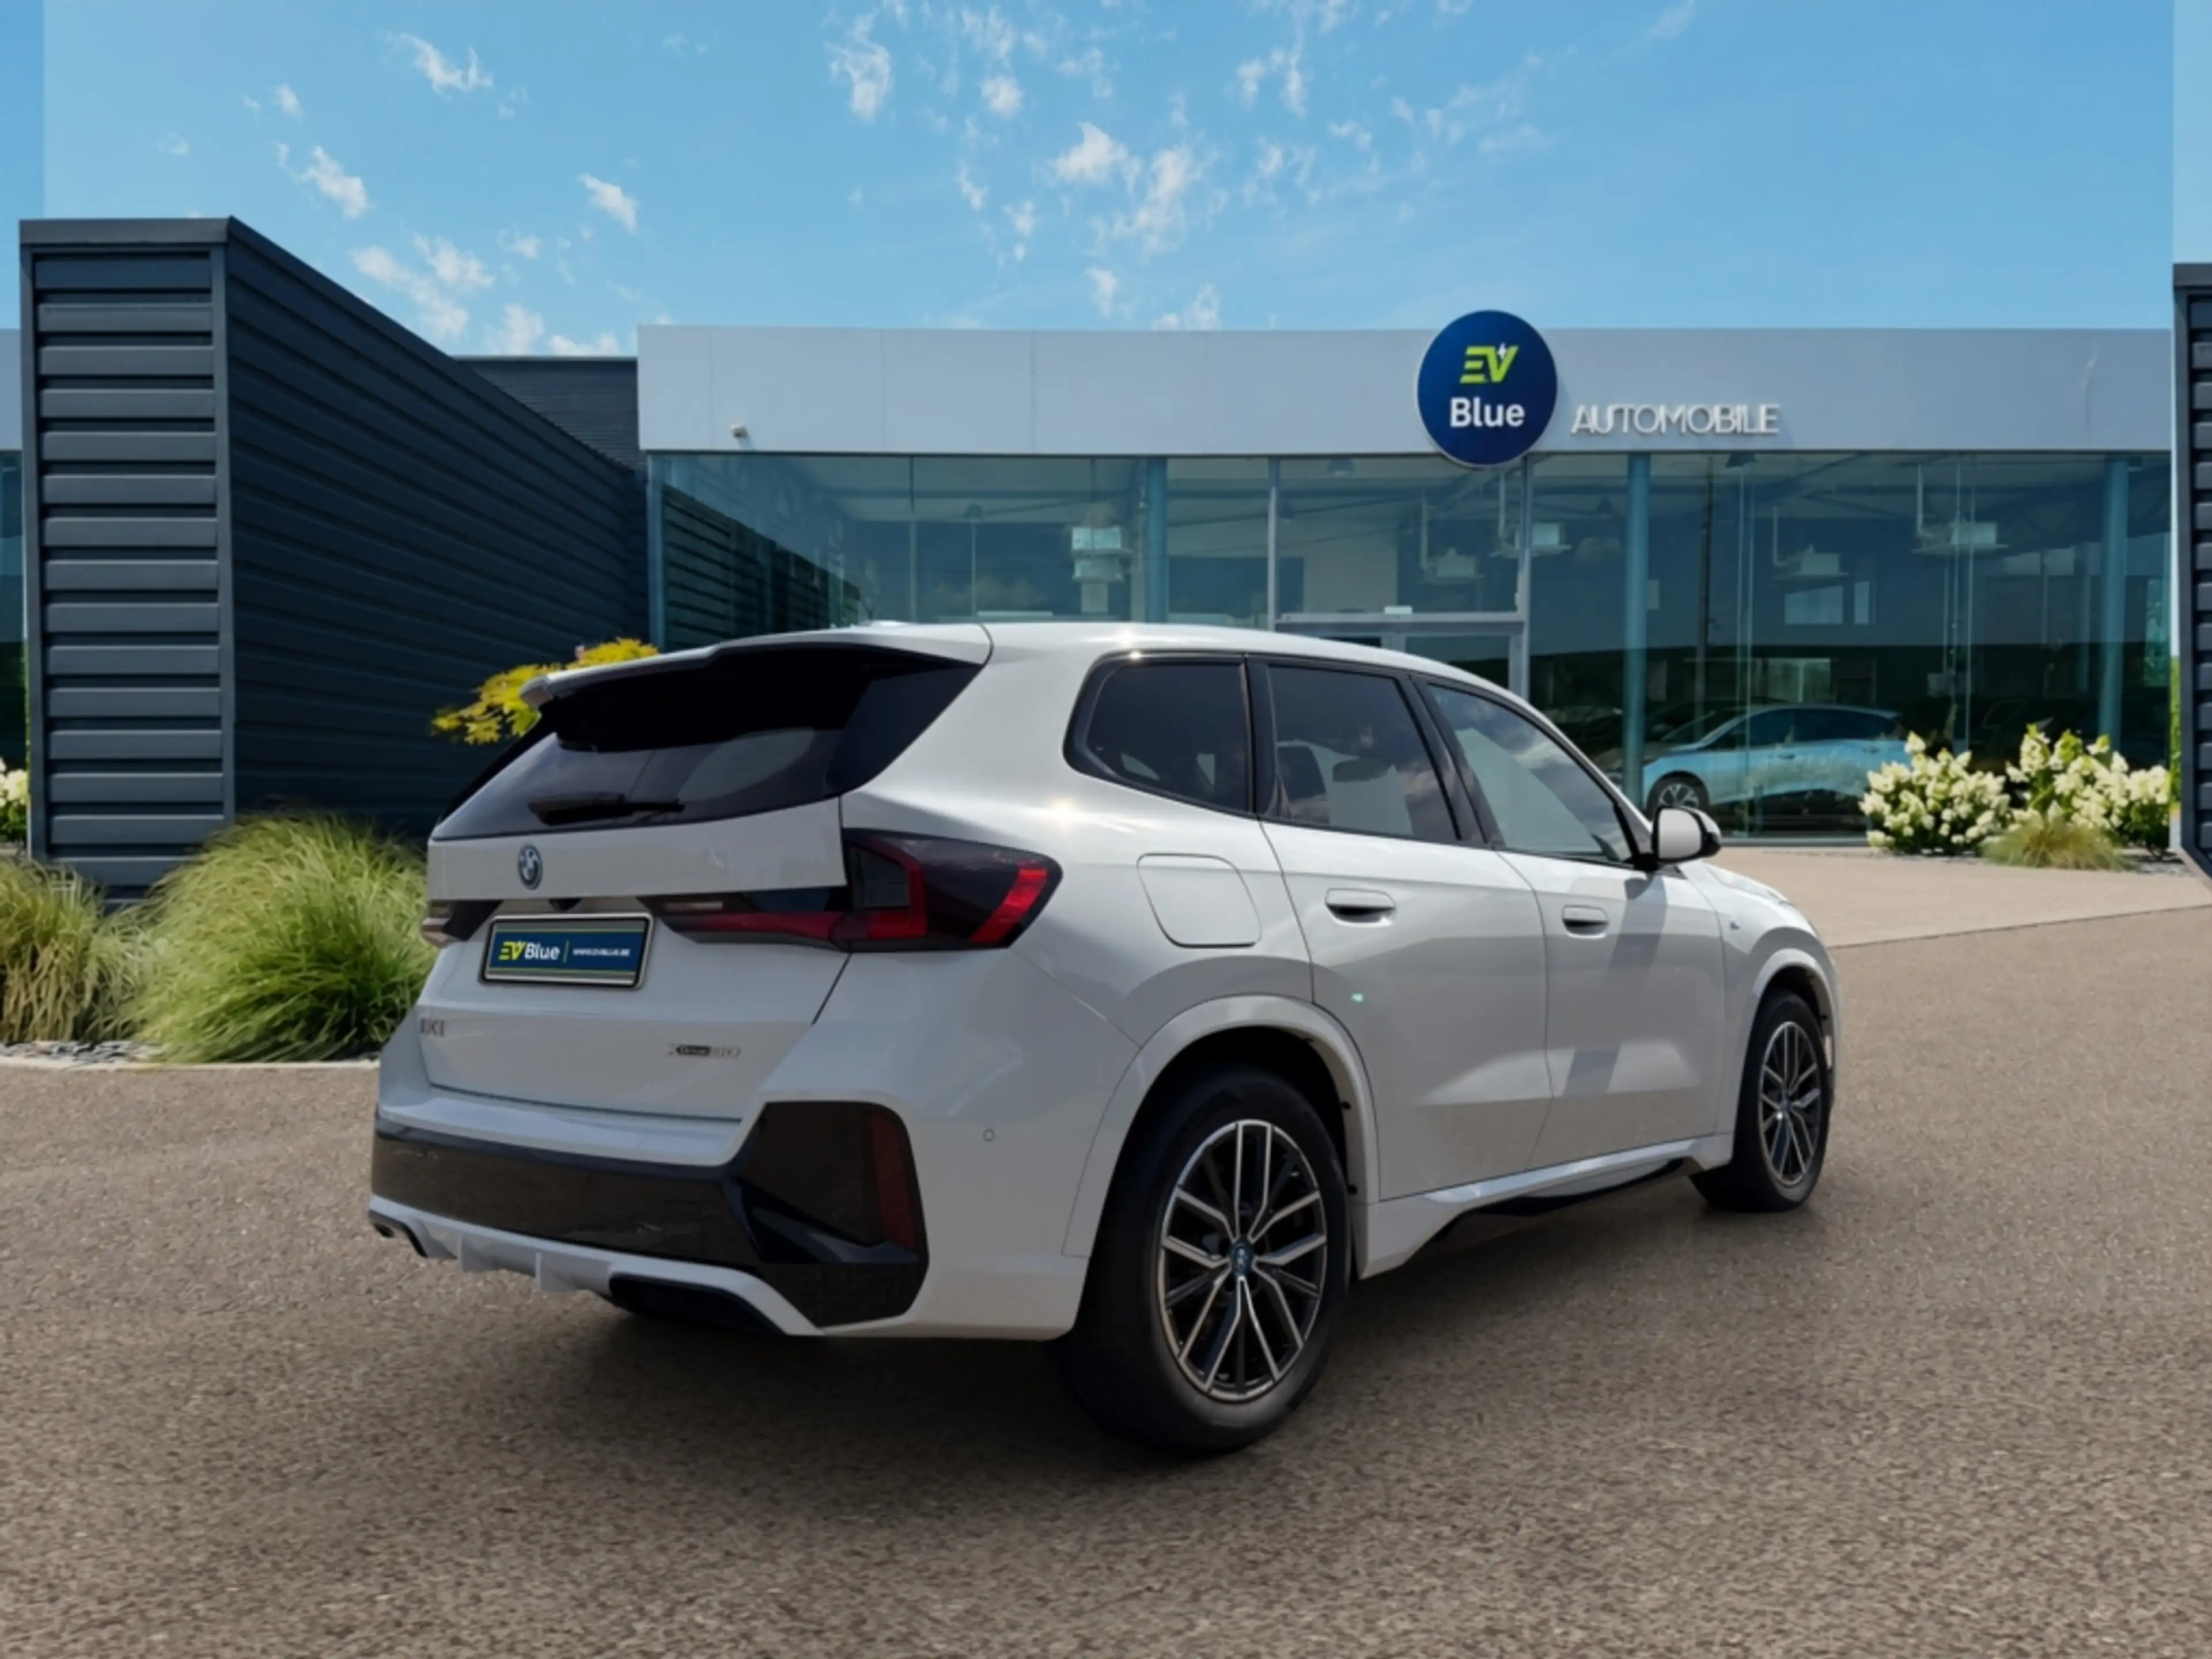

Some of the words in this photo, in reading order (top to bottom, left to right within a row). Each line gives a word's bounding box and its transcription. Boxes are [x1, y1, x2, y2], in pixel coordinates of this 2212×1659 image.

[1460, 345, 1519, 384] EV
[1450, 396, 1525, 427] Blue
[1570, 403, 1780, 434] AUTOMOBILE
[498, 941, 526, 960] EV
[525, 942, 560, 960] Blue
